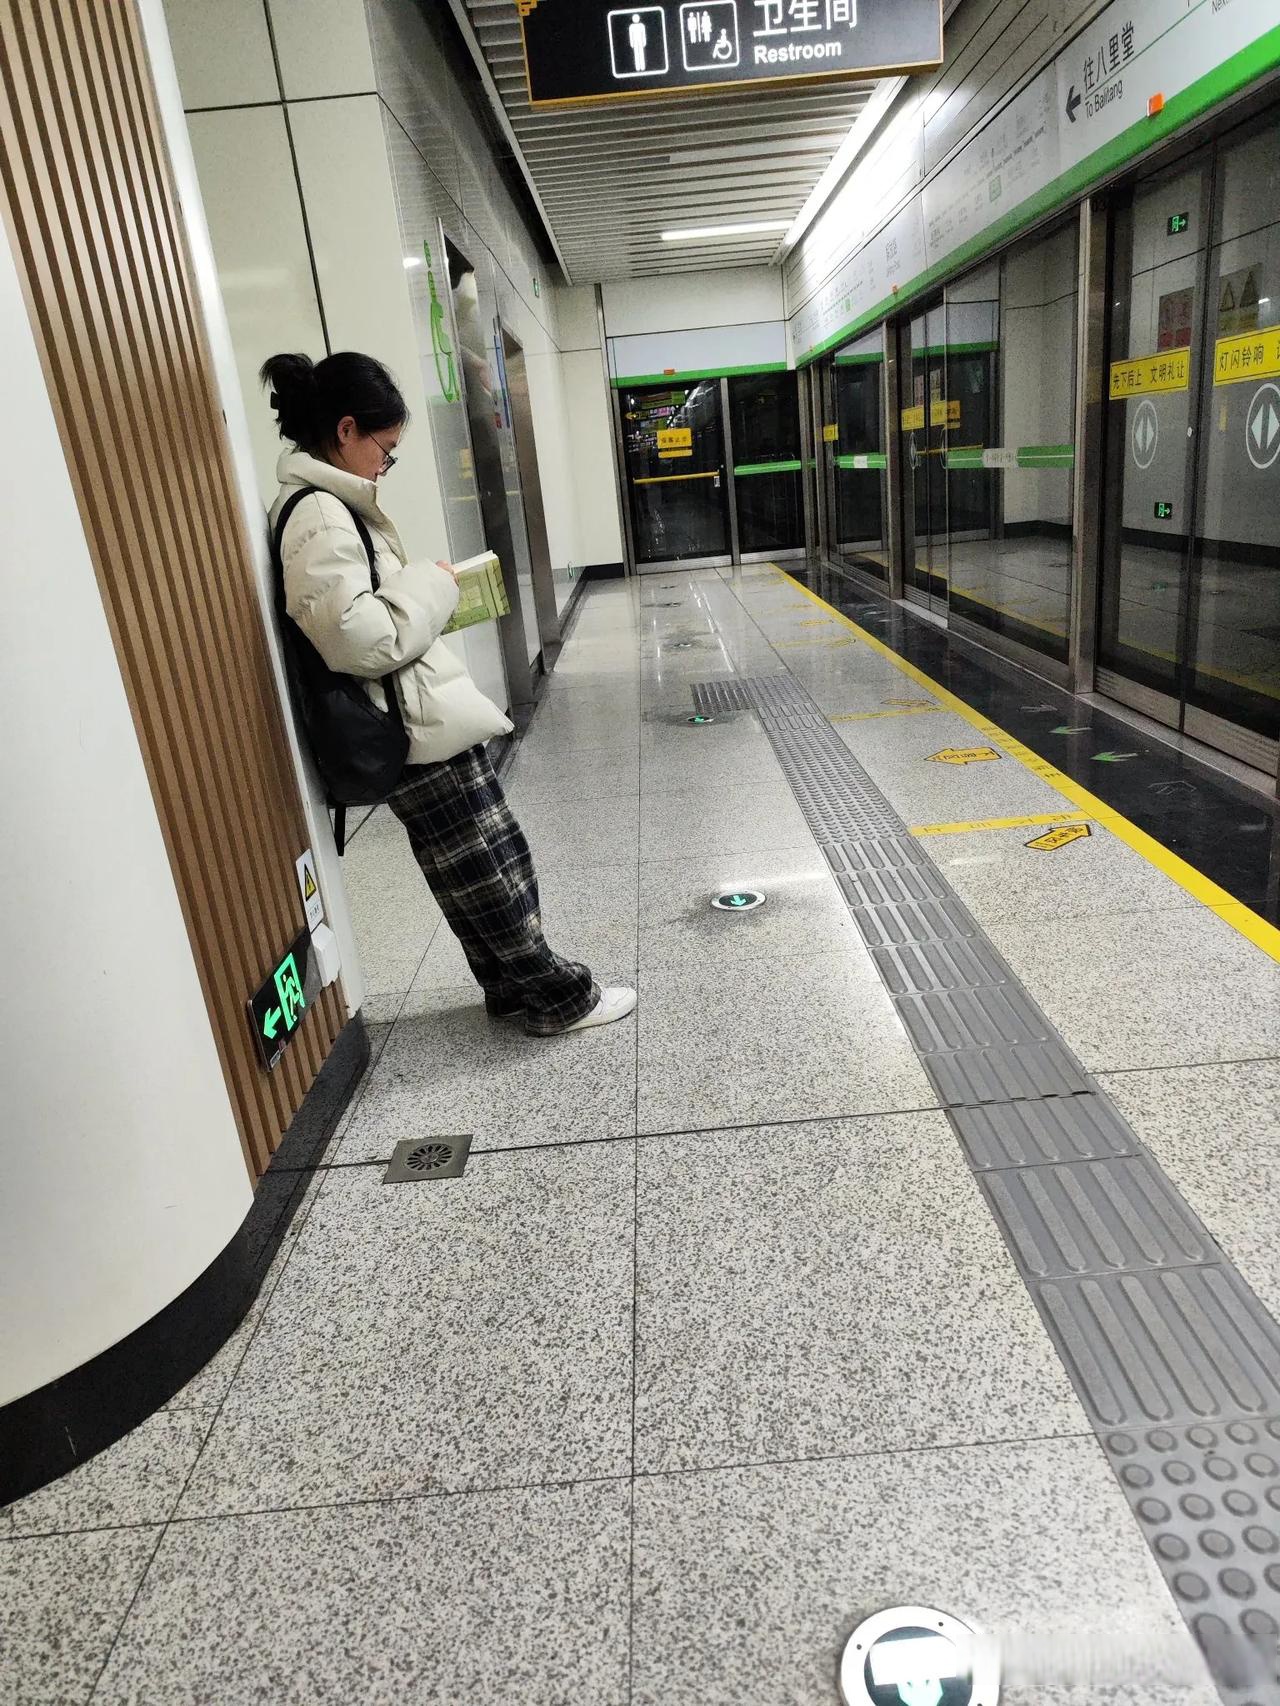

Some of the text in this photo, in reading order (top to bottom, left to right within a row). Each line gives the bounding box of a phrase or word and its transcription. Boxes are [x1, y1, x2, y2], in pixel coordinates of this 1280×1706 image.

[753, 0, 858, 37] 卫生间
[754, 41, 842, 65] Restroom
[1083, 20, 1135, 93] 往八里堂
[1084, 100, 1094, 119] To
[1219, 343, 1265, 372] 灯闪铃响
[1113, 360, 1185, 391] 先下后上 文明礼让
